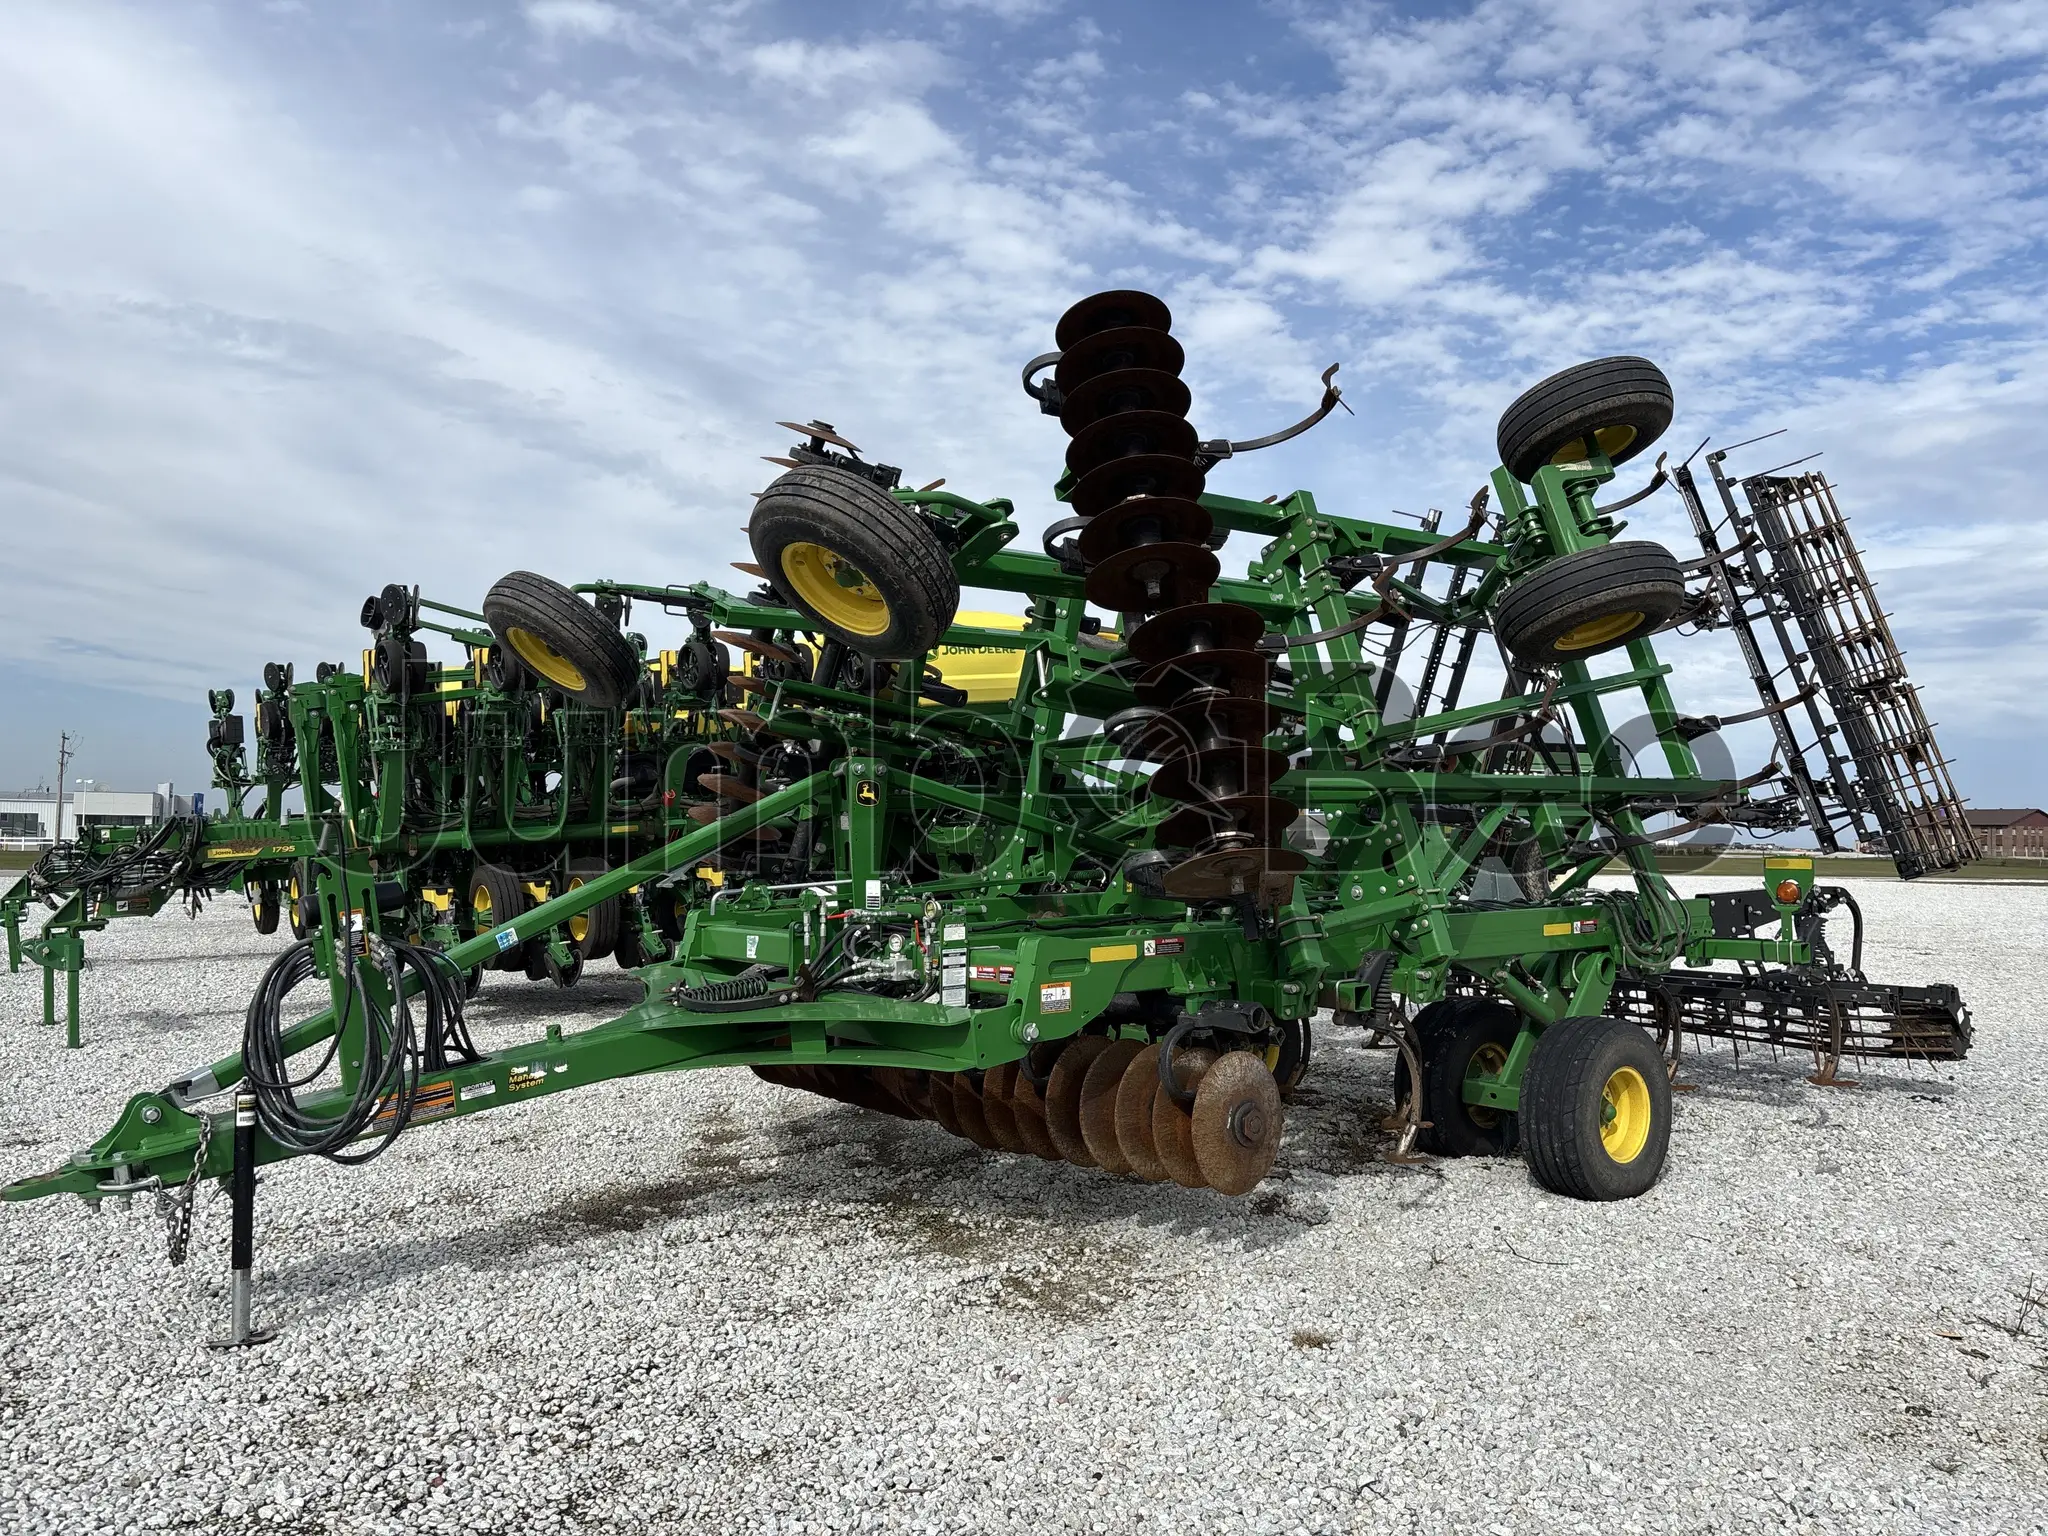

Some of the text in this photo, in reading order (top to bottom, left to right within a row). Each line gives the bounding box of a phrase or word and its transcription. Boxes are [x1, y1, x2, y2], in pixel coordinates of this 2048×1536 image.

[942, 646, 1017, 655] JOHN DEERE
[272, 845, 296, 853] 1795
[508, 1078, 544, 1091] System
